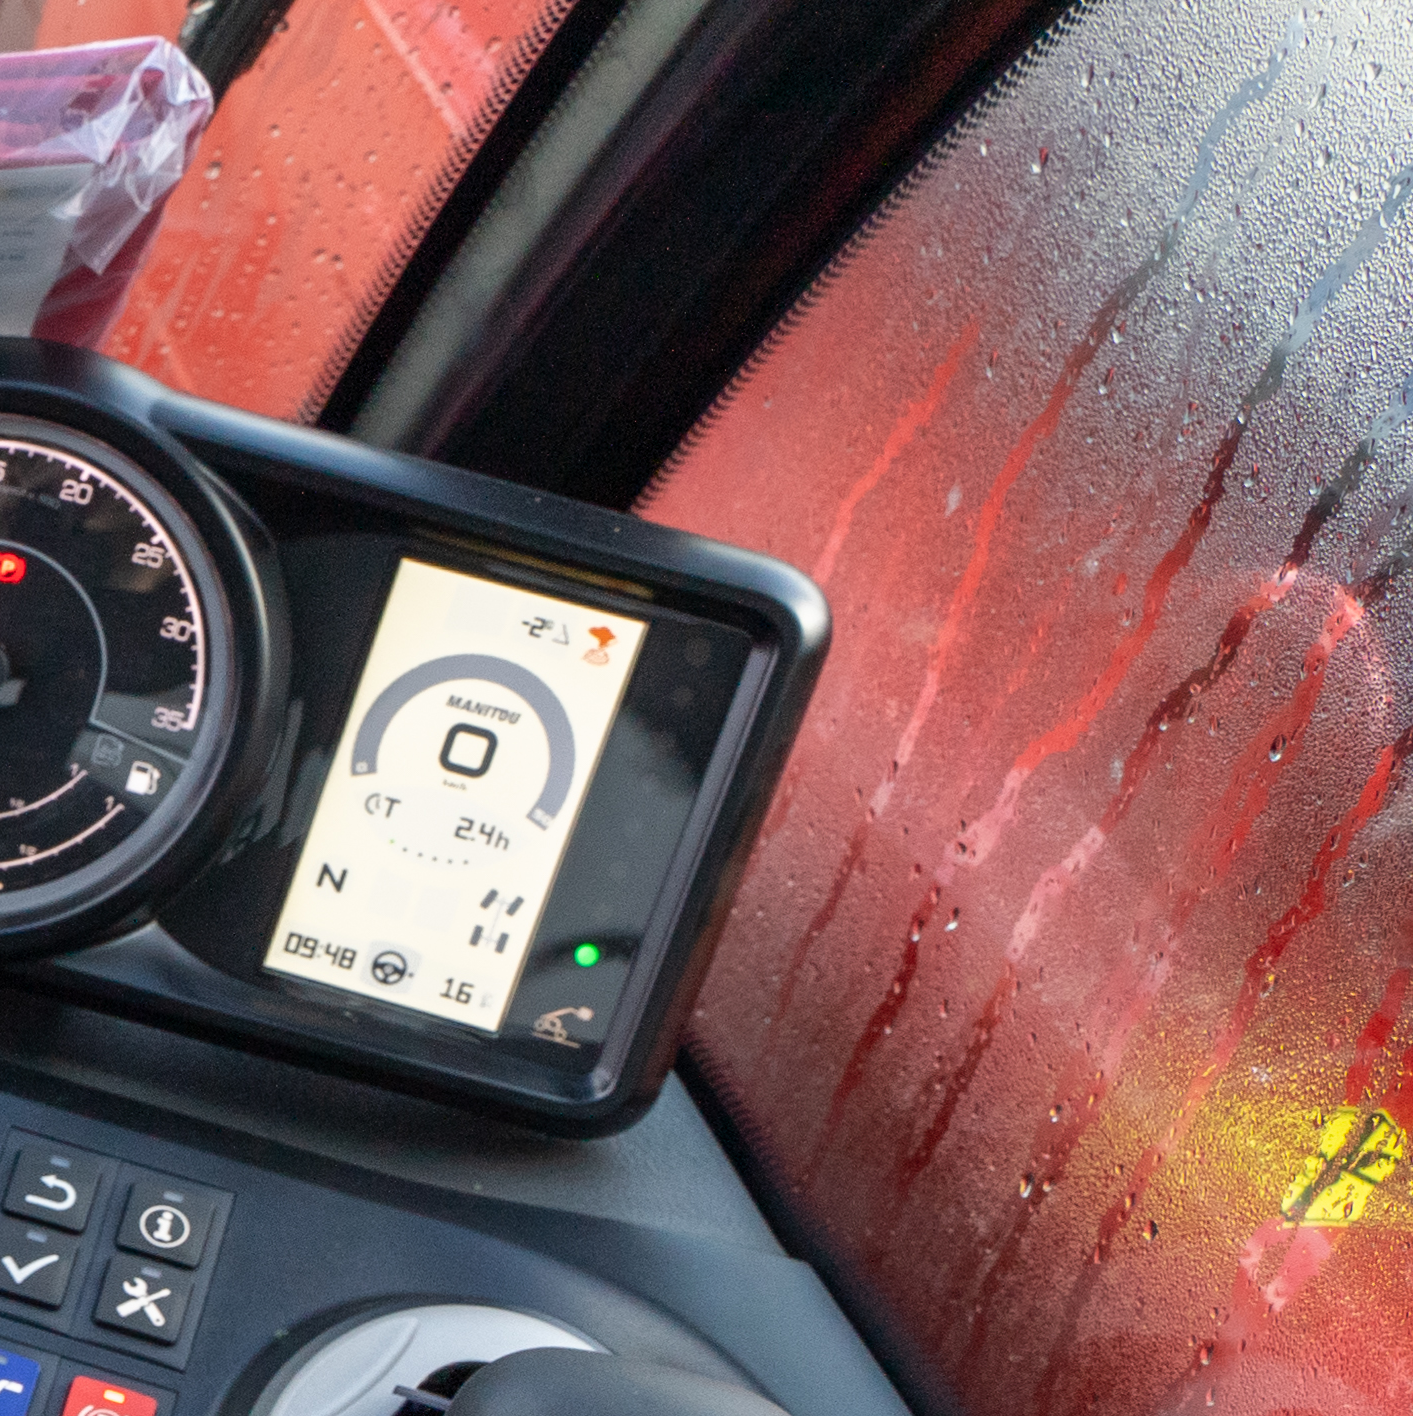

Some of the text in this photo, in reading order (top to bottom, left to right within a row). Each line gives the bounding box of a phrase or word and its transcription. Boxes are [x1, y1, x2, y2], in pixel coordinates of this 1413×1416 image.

[59, 479, 93, 505] 20
[131, 542, 165, 569] 25
[159, 616, 192, 642] 30
[151, 706, 186, 732] 35
[446, 695, 521, 725] MANITOU
[438, 722, 499, 778] 0
[316, 862, 349, 893] N
[283, 931, 358, 971] 09:48
[439, 976, 475, 1005] 16
